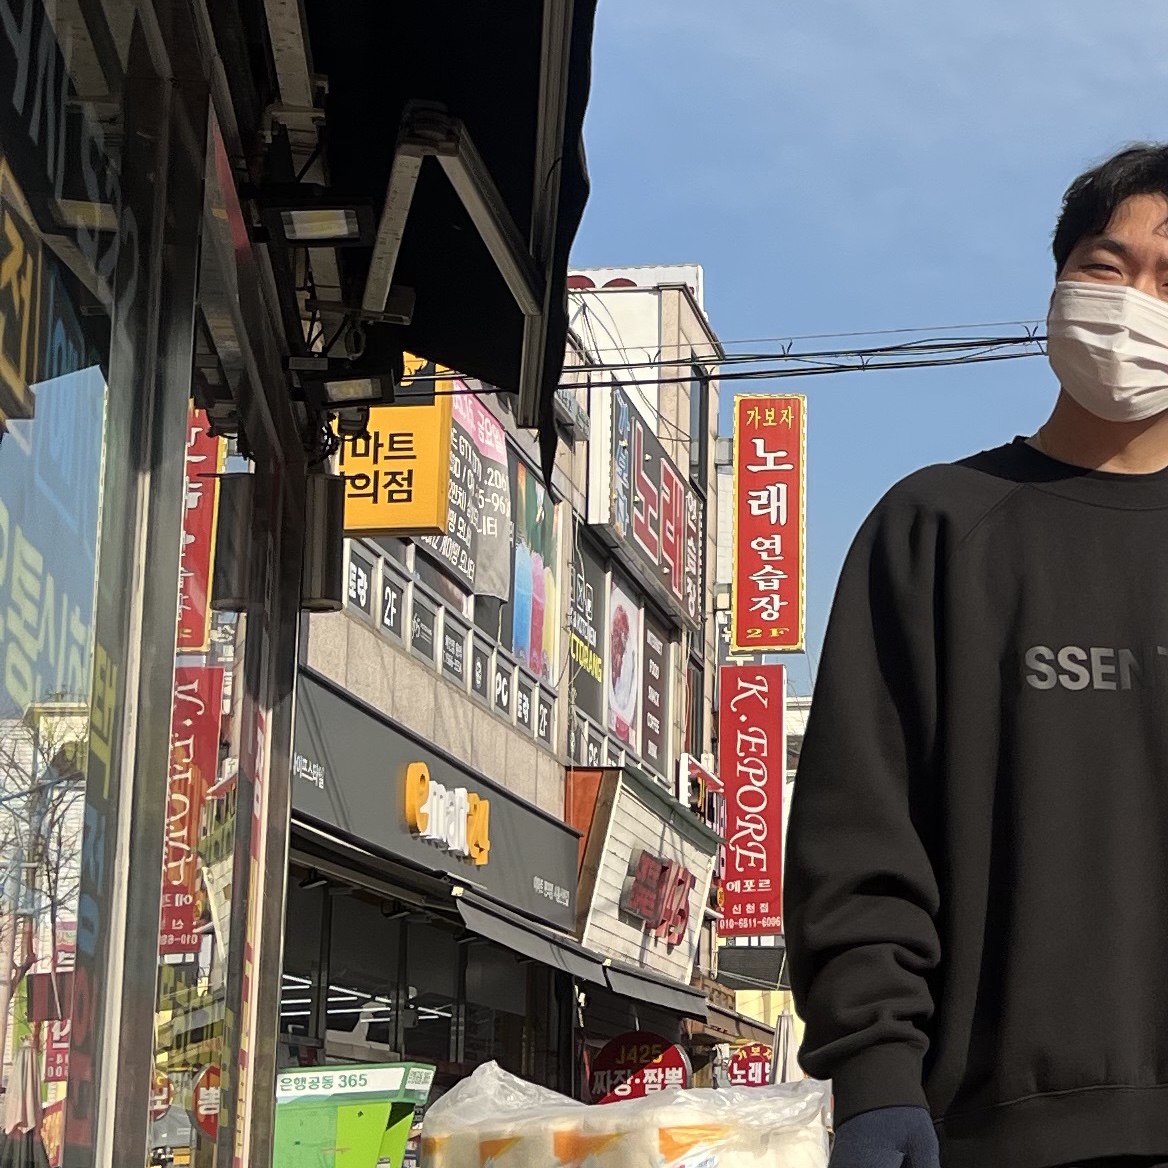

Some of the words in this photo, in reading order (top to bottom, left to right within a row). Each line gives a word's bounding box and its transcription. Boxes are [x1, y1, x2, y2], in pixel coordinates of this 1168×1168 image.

[746, 405, 795, 430] 가보자
[384, 586, 398, 627] 2F
[746, 627, 790, 639] 2F
[538, 703, 549, 737] 2F
[726, 878, 772, 894] 에포르
[279, 1075, 334, 1092] 은행공동
[338, 1073, 368, 1089] 365
